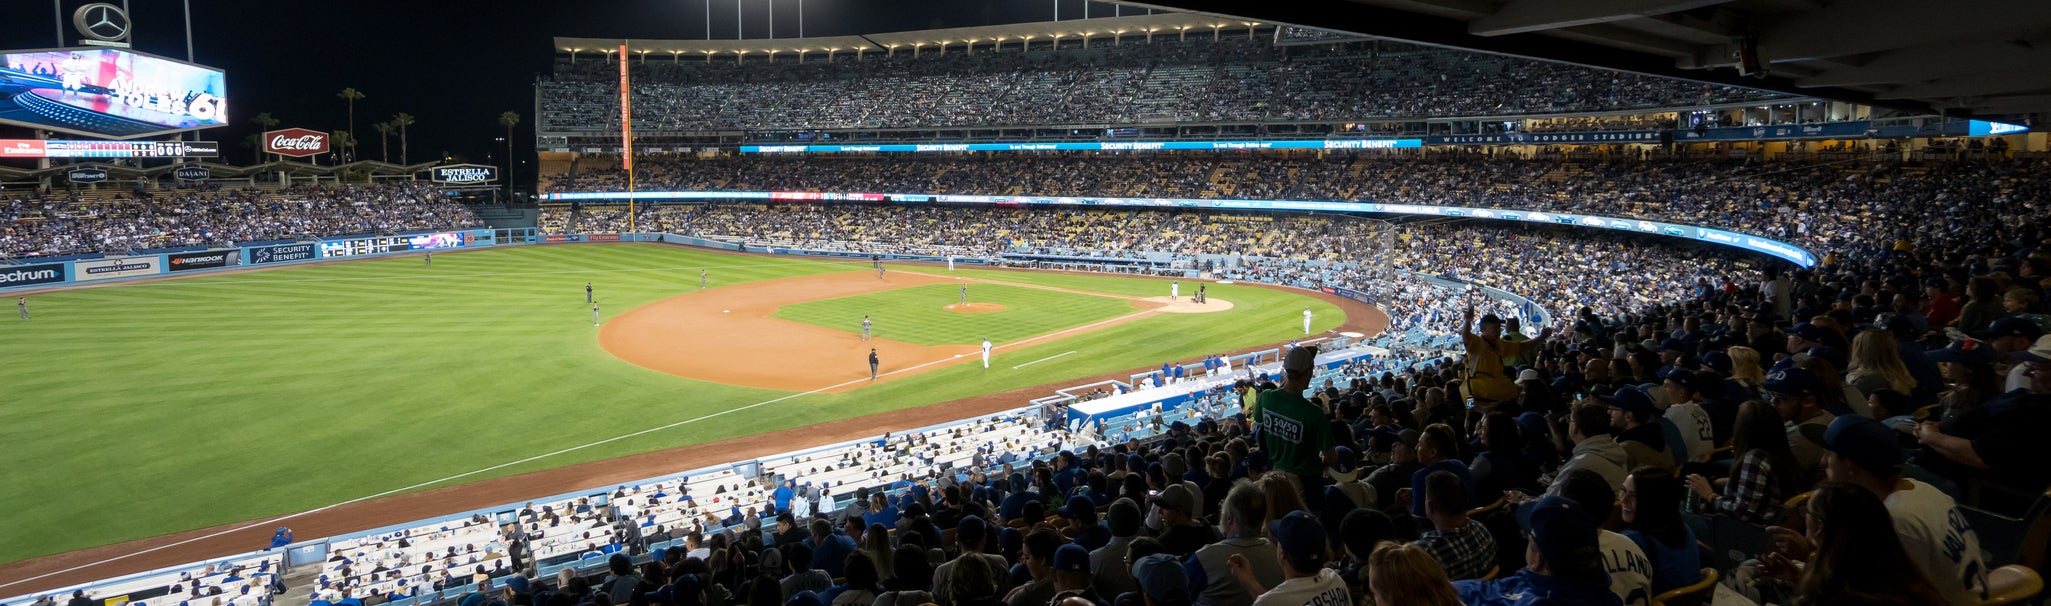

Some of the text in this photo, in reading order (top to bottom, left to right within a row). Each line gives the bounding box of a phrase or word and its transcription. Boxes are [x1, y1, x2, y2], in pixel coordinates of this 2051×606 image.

[271, 134, 324, 150] Coca-Cola
[273, 245, 310, 254] SECURITY
[1273, 417, 1298, 433] 50/50
